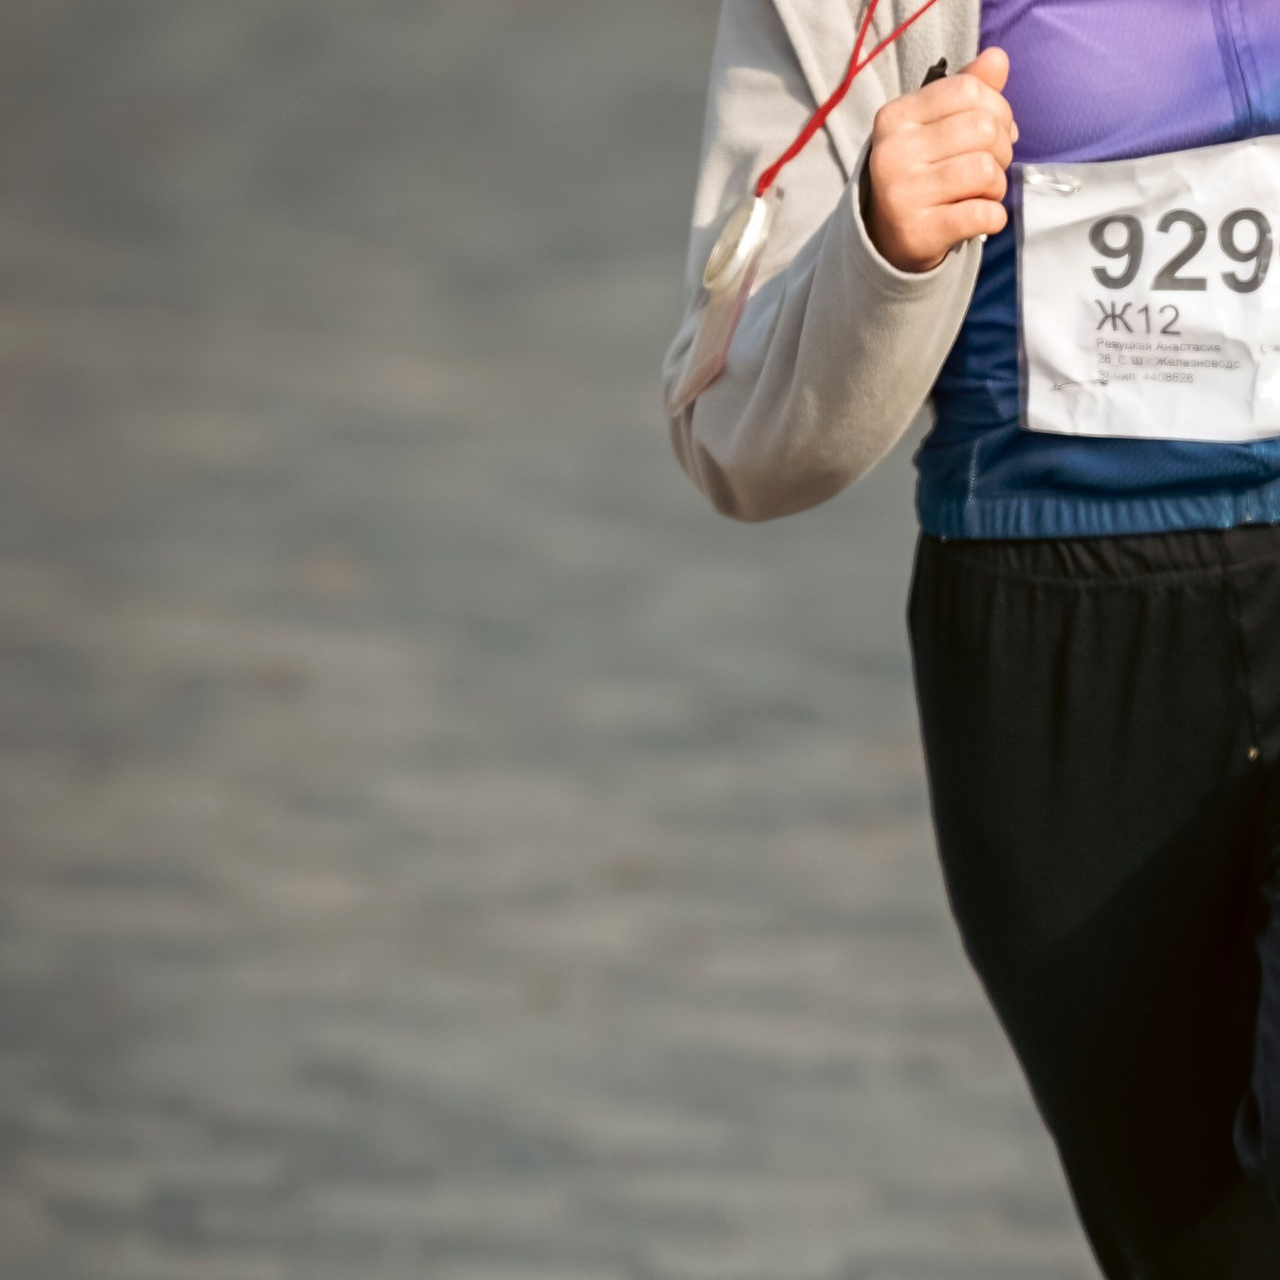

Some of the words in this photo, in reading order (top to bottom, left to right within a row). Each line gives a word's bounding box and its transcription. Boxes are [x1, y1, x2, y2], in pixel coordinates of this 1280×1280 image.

[1094, 299, 1181, 336] Ж12
[1096, 338, 1152, 352] Ревуцкая
[1156, 342, 1221, 353] Анастасия
